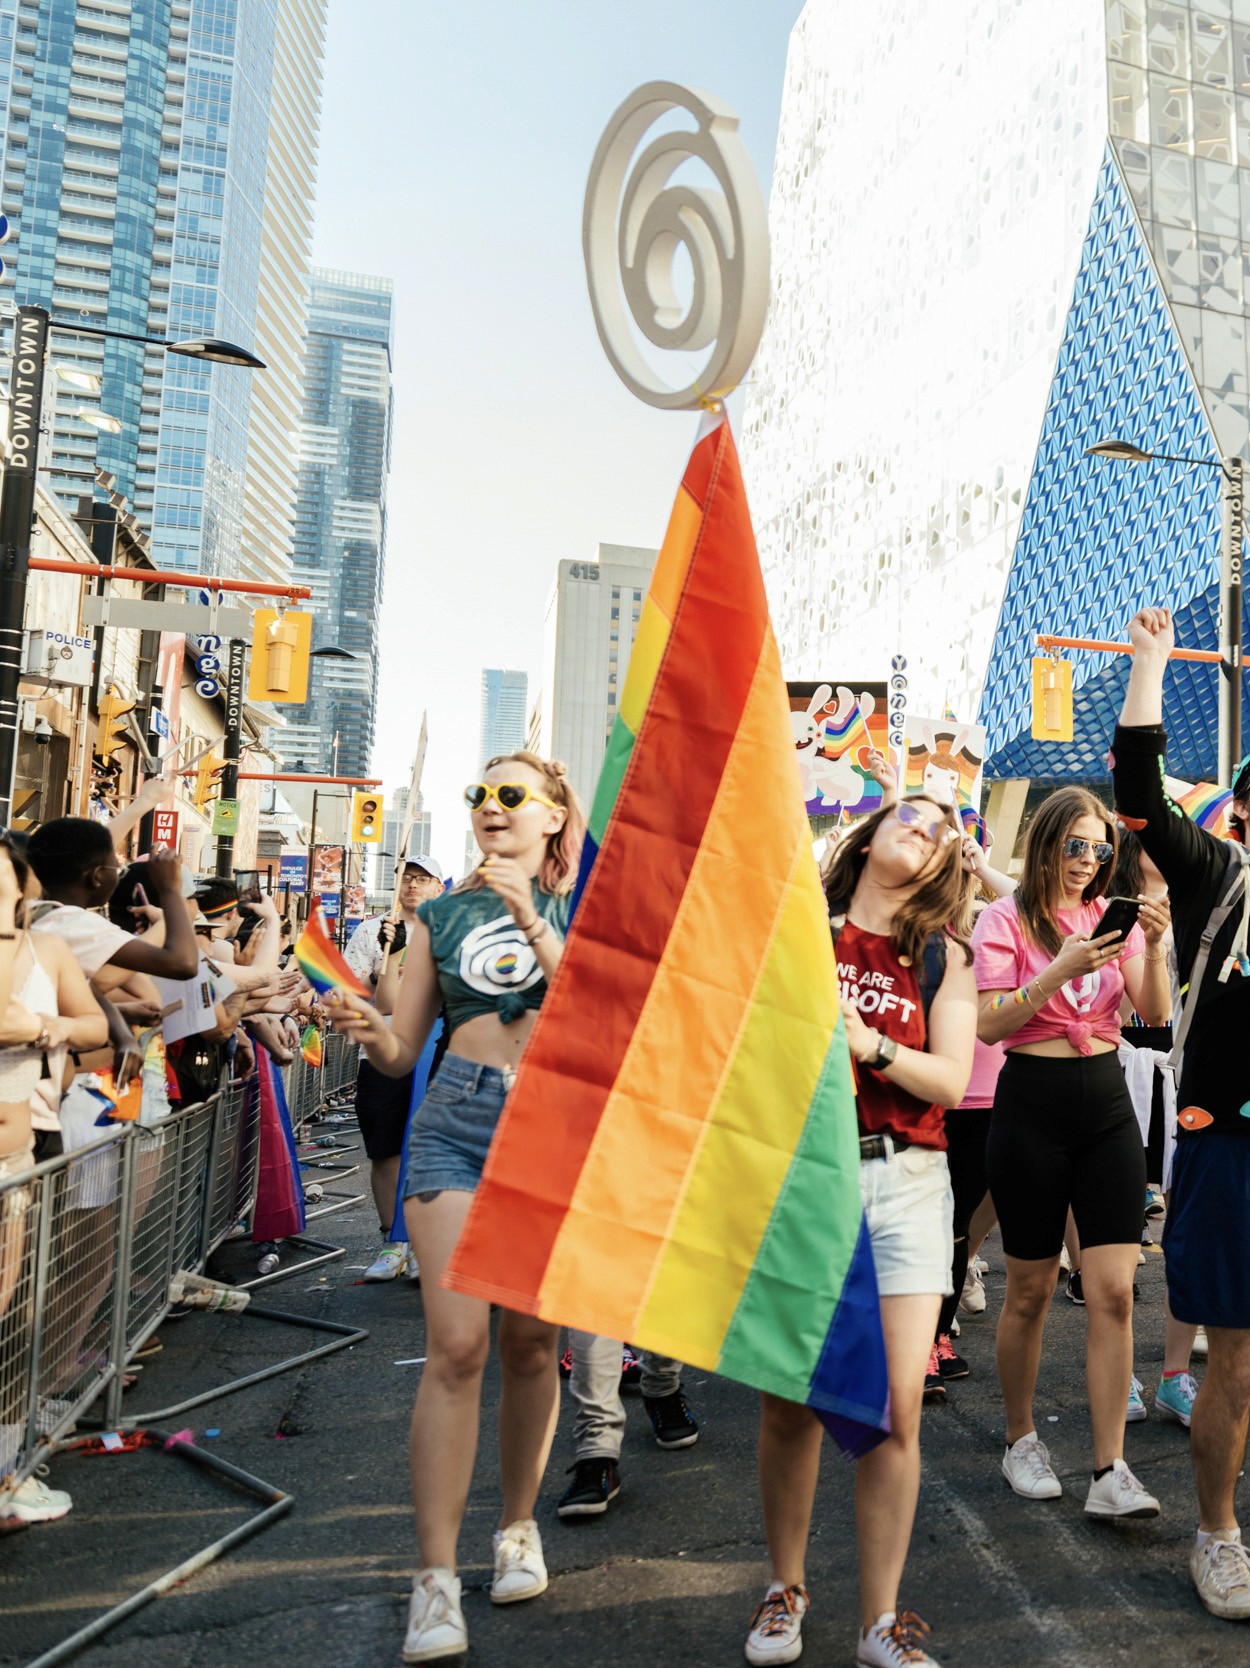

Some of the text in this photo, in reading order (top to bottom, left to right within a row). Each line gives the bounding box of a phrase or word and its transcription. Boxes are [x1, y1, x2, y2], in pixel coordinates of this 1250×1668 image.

[10, 317, 39, 468] DOWNTOWN
[1230, 466, 1242, 585] DOWNTOWN
[570, 562, 600, 580] 415
[46, 631, 92, 649] POLICE
[228, 645, 242, 727] DOWNTOWN
[858, 971, 895, 991] ARE
